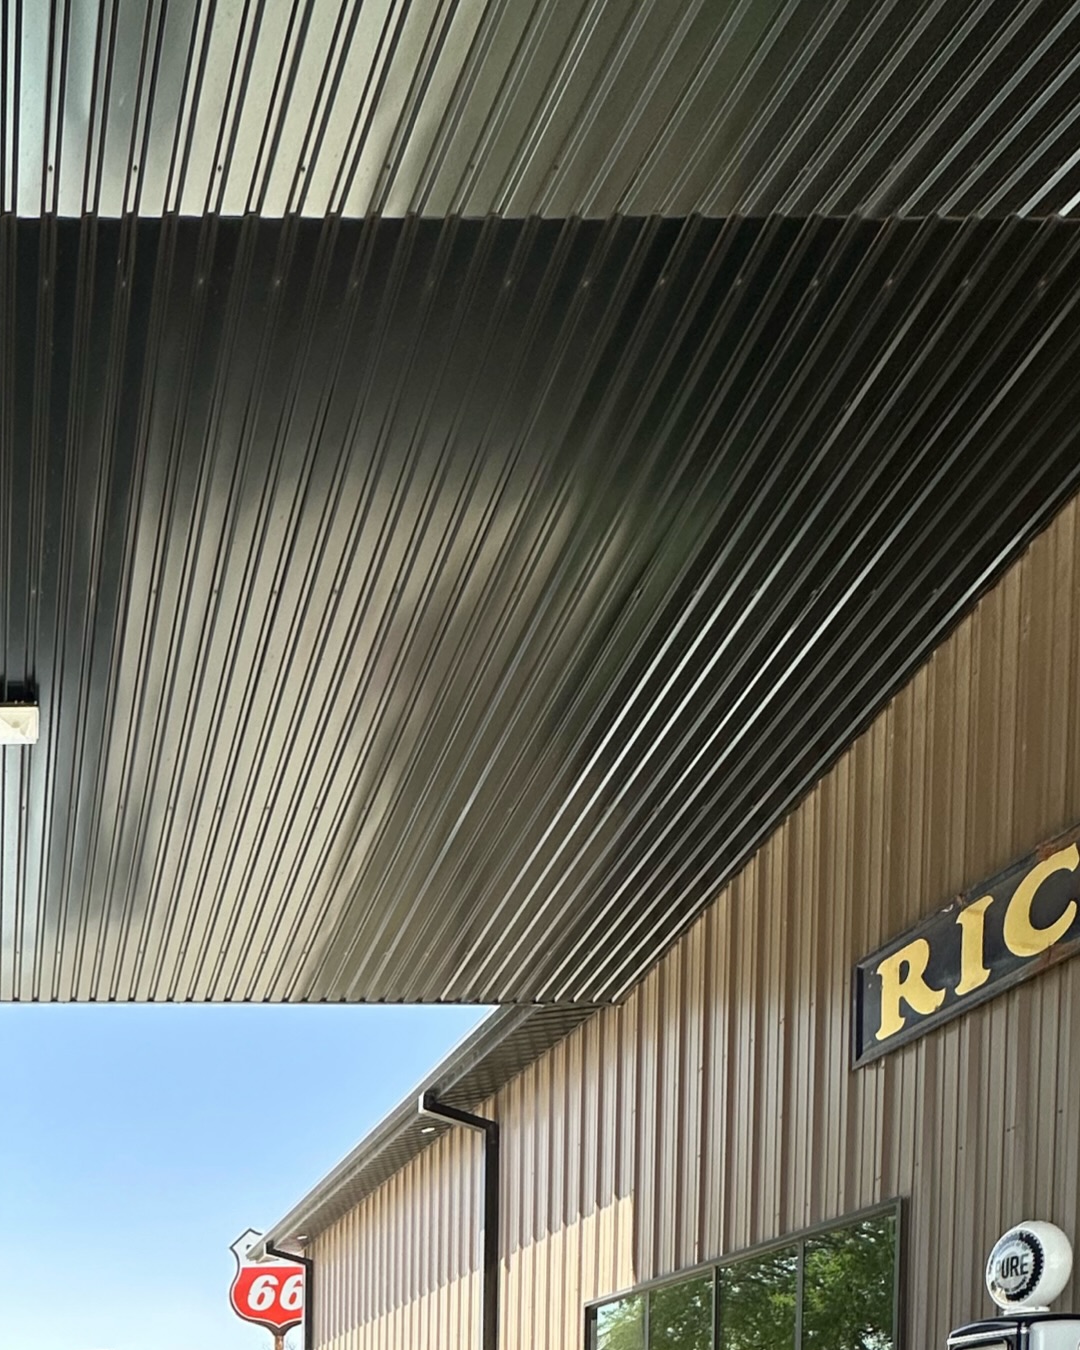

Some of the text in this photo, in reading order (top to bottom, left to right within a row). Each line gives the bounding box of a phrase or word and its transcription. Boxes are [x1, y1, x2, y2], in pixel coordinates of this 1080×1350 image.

[875, 842, 1080, 1041] RIC
[996, 1253, 1029, 1279] PURE
[247, 1274, 303, 1311] 66
